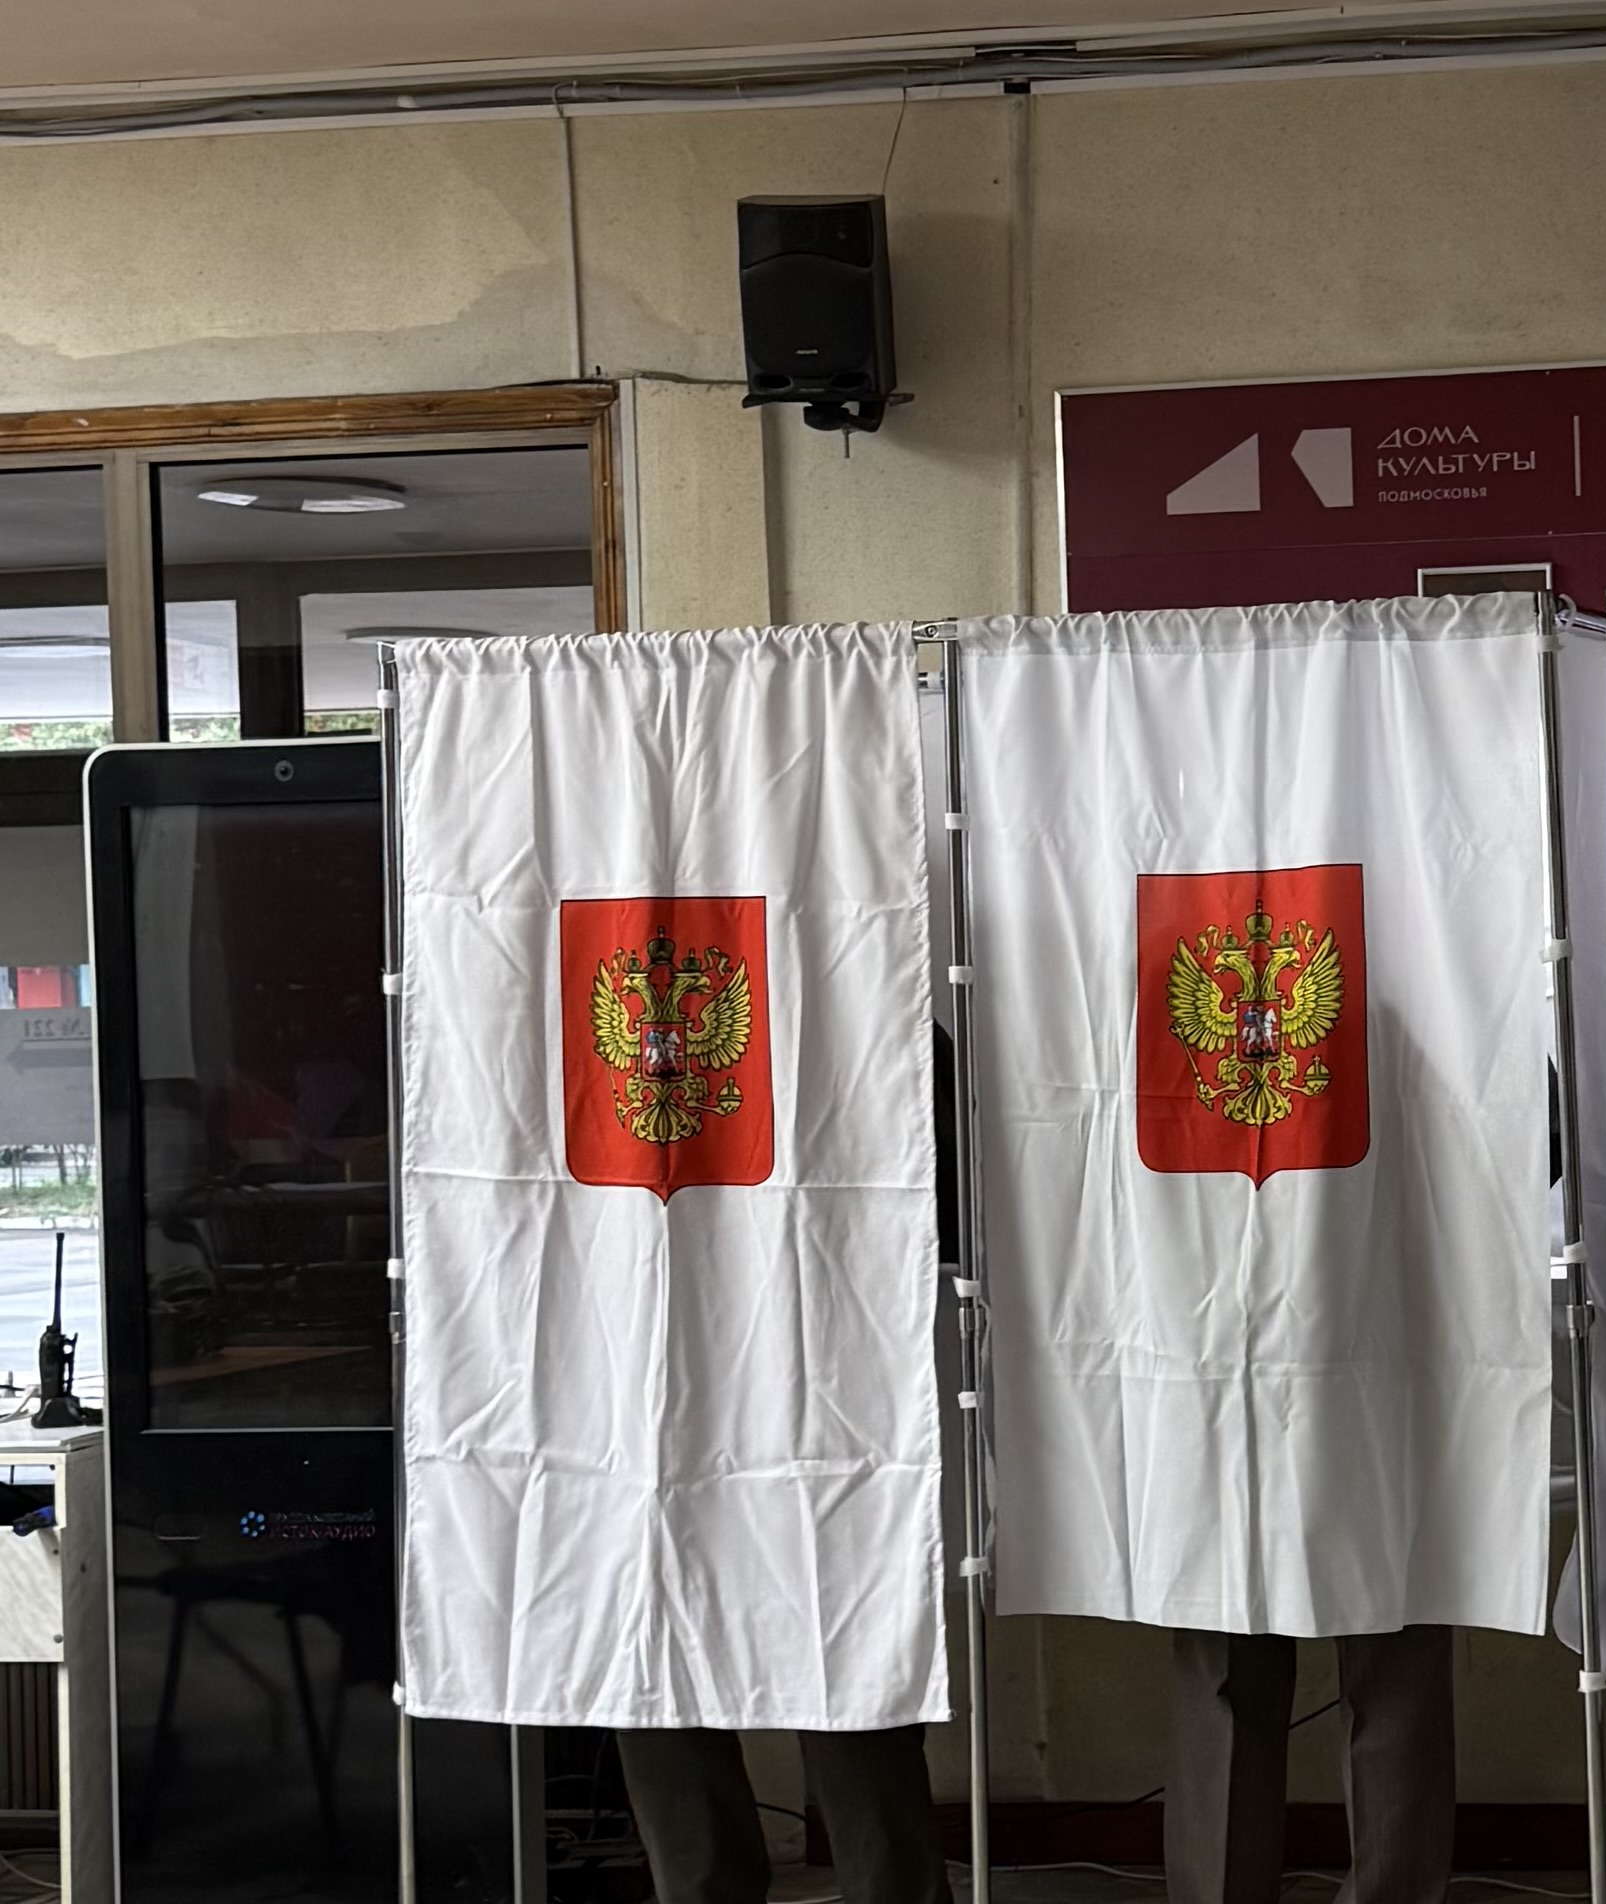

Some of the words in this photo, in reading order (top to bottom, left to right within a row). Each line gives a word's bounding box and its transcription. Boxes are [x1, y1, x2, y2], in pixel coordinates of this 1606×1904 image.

[1377, 424, 1480, 449] ДОМА
[1377, 450, 1537, 478] КУЛЬТУРЫ
[1377, 486, 1488, 503] ПОДМОСКОВЬЯ
